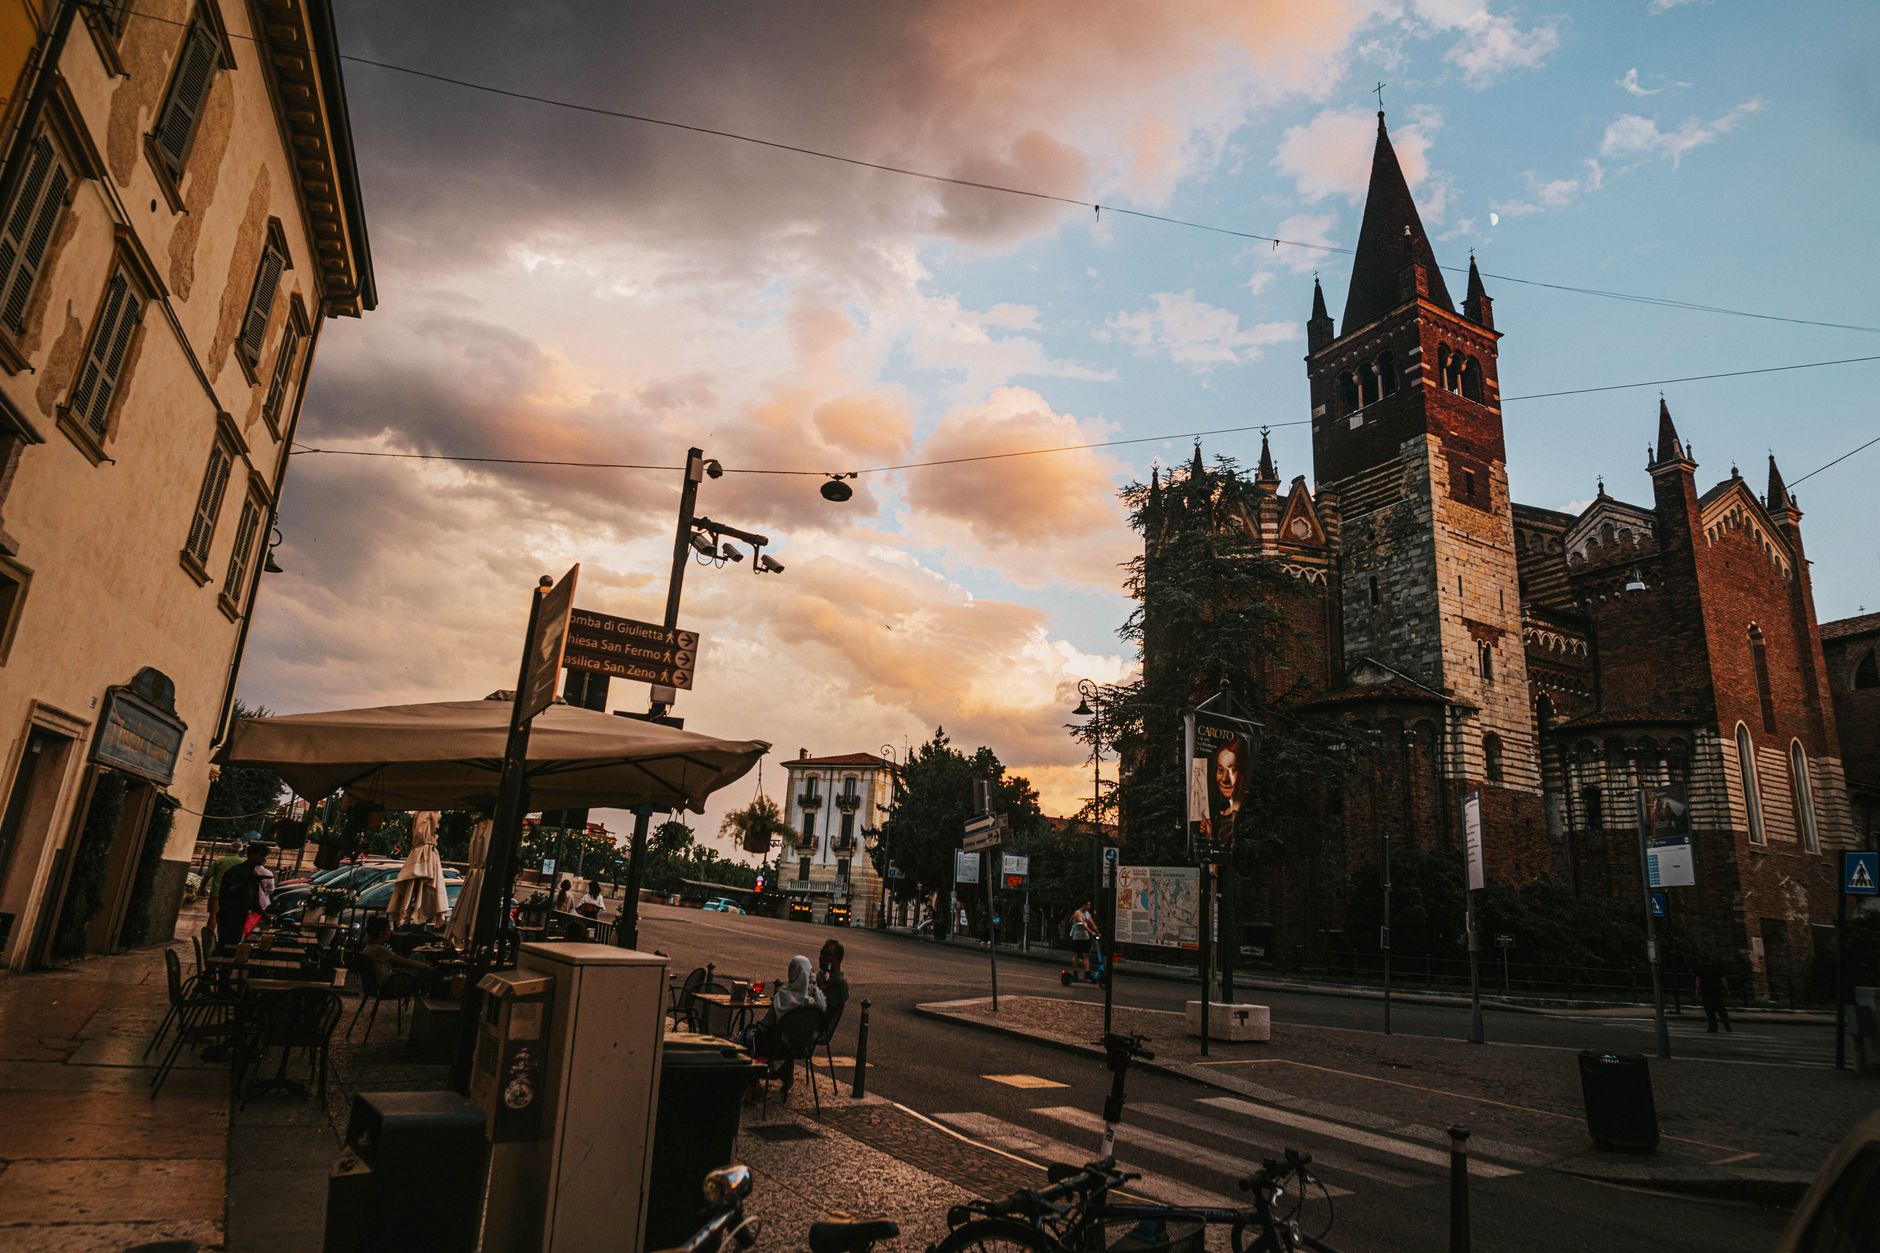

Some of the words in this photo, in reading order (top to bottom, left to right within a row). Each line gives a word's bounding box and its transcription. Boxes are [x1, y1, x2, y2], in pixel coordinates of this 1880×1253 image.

[570, 615, 601, 628] omba
[604, 620, 615, 631] di
[617, 623, 663, 640] Giulietta
[567, 632, 598, 648] hiesa
[600, 639, 622, 653] San
[625, 643, 661, 660] Fermo
[564, 655, 601, 669] asilica
[603, 660, 625, 673] San
[627, 664, 656, 679] Zeno
[1197, 725, 1234, 741] CAROTO
